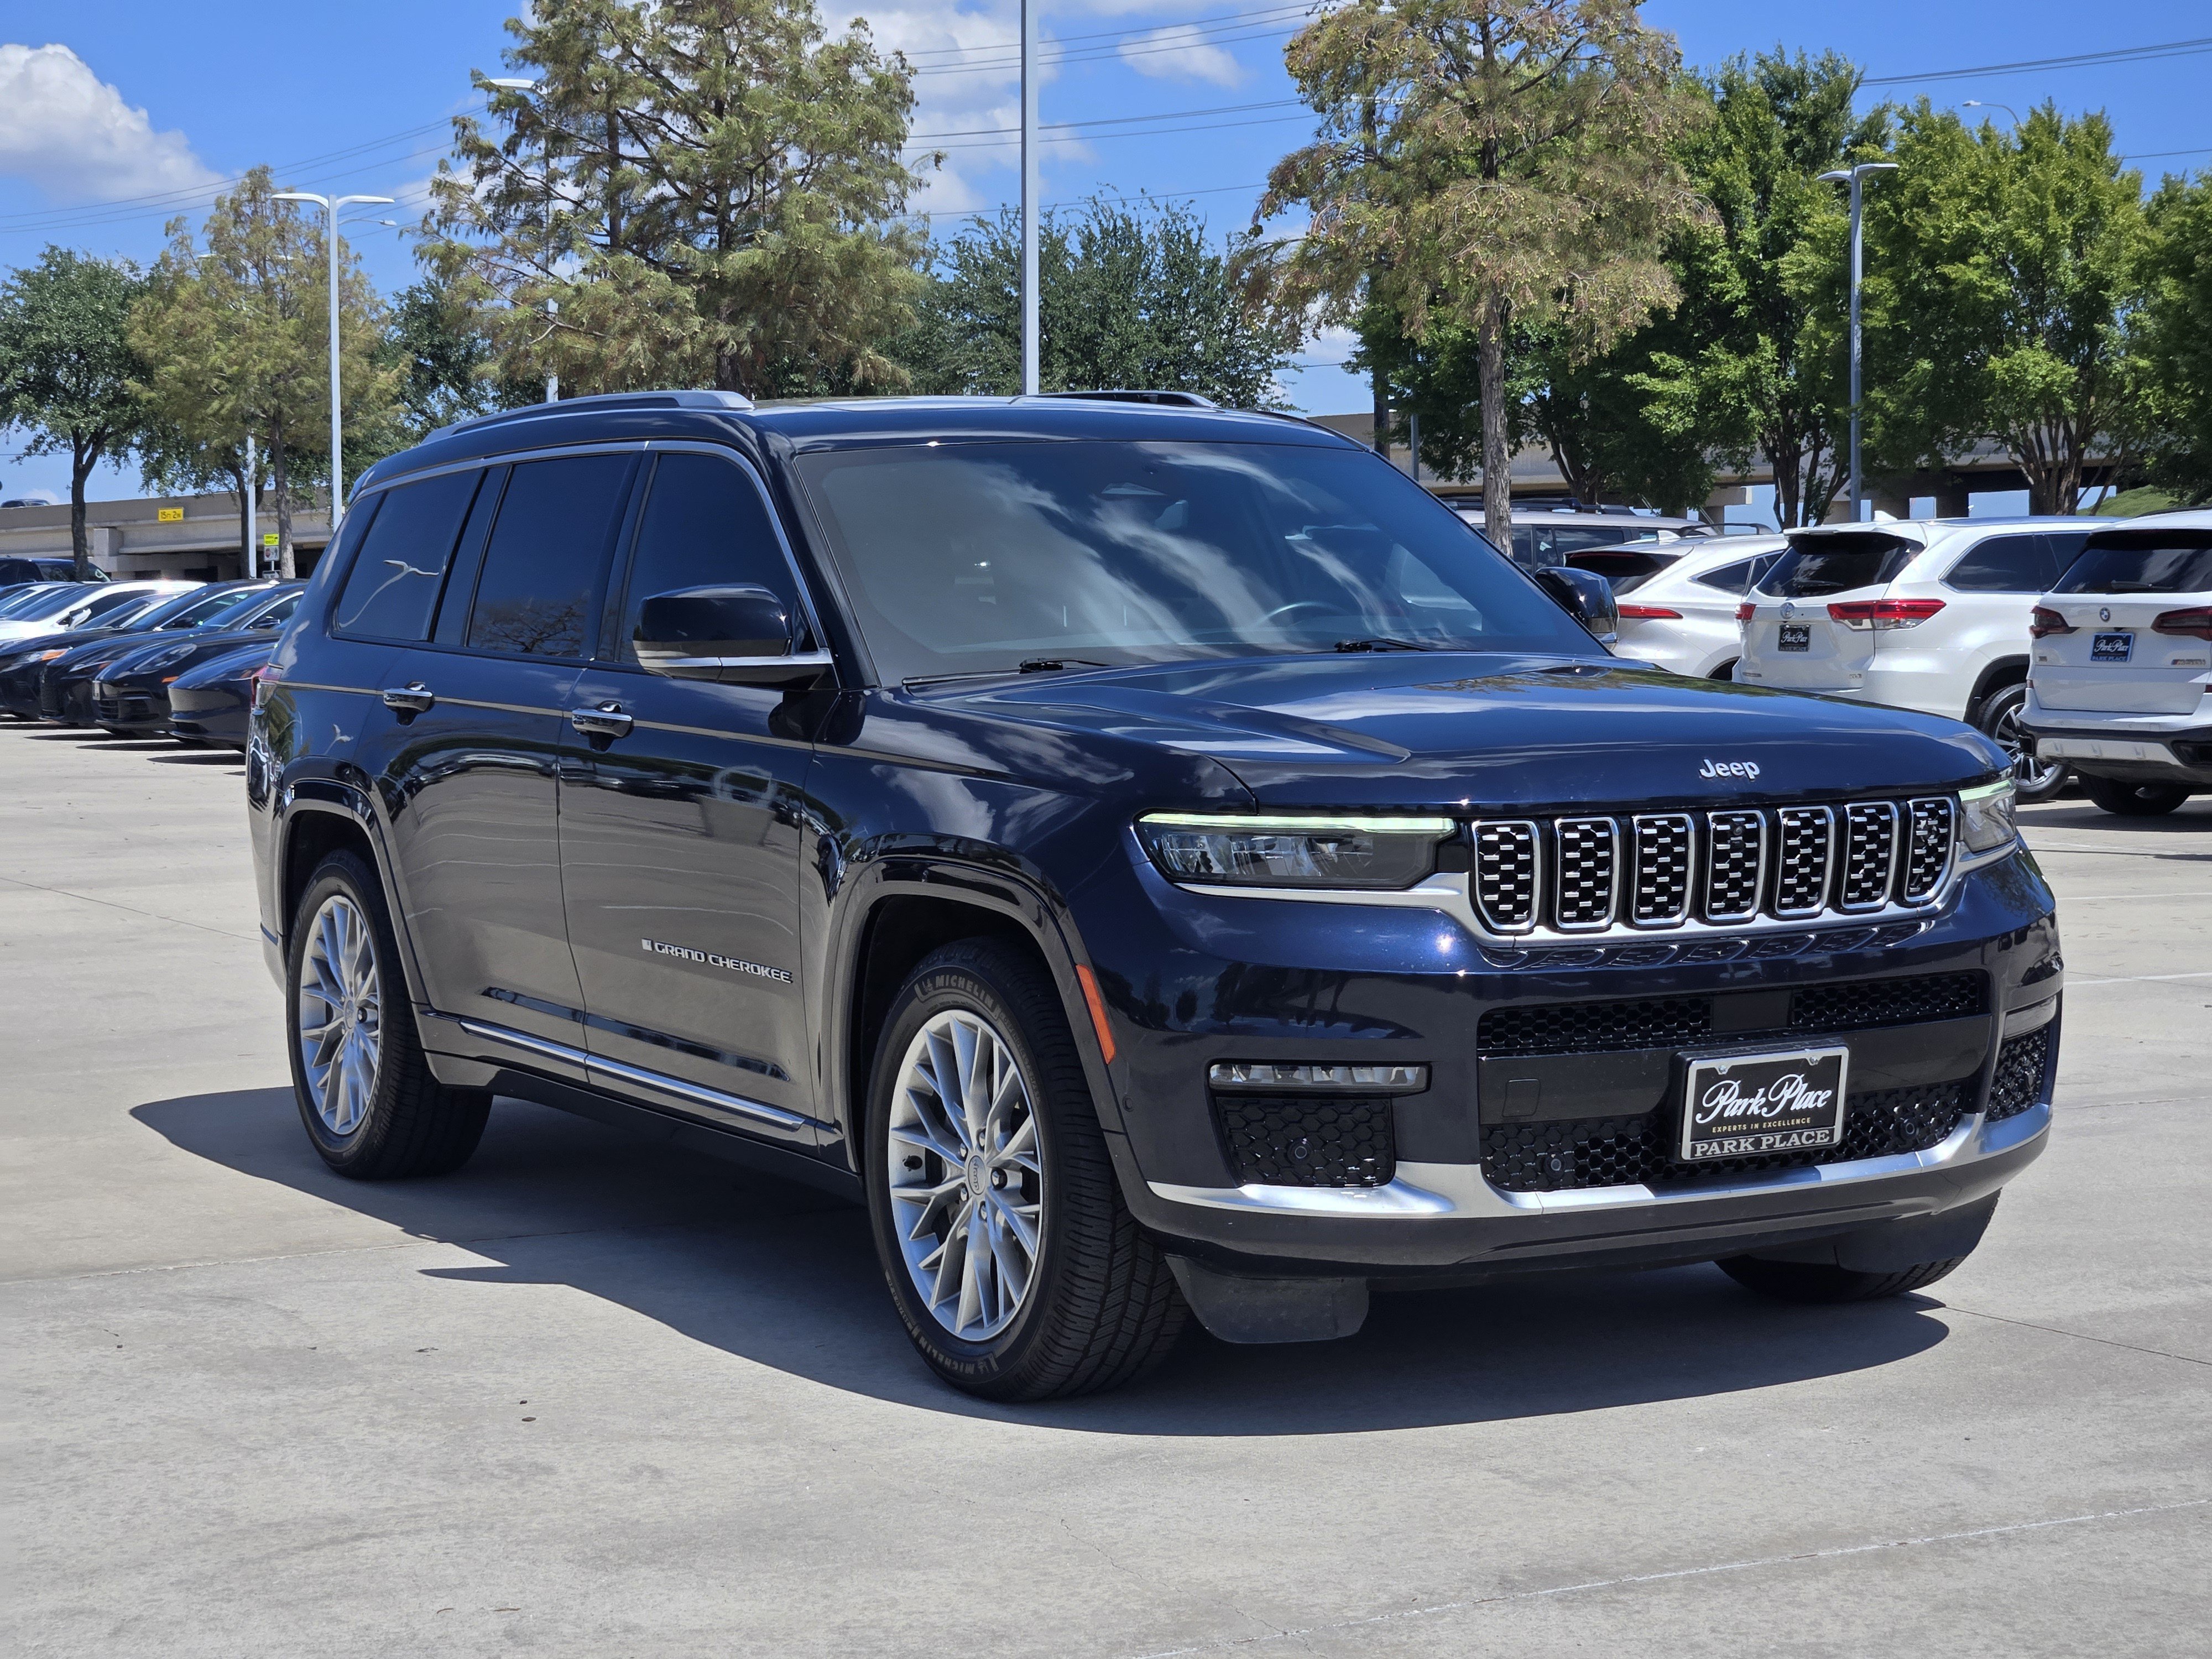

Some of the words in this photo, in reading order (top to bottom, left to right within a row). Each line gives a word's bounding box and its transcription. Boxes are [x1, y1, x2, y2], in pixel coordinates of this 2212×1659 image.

[1699, 759, 1760, 780] Jeep
[654, 941, 707, 963] GRAND
[708, 953, 793, 984] CHEROKEE
[935, 974, 994, 1009] MICHELIN
[1695, 1080, 1766, 1124] Park
[1761, 1074, 1833, 1118] Place
[1694, 1138, 1755, 1156] PARK
[1761, 1129, 1830, 1149] PLACE
[1712, 1124, 1747, 1133] EXPERTS
[1762, 1117, 1811, 1129] EXCELLENCE
[918, 1335, 975, 1375] MICHELIN
